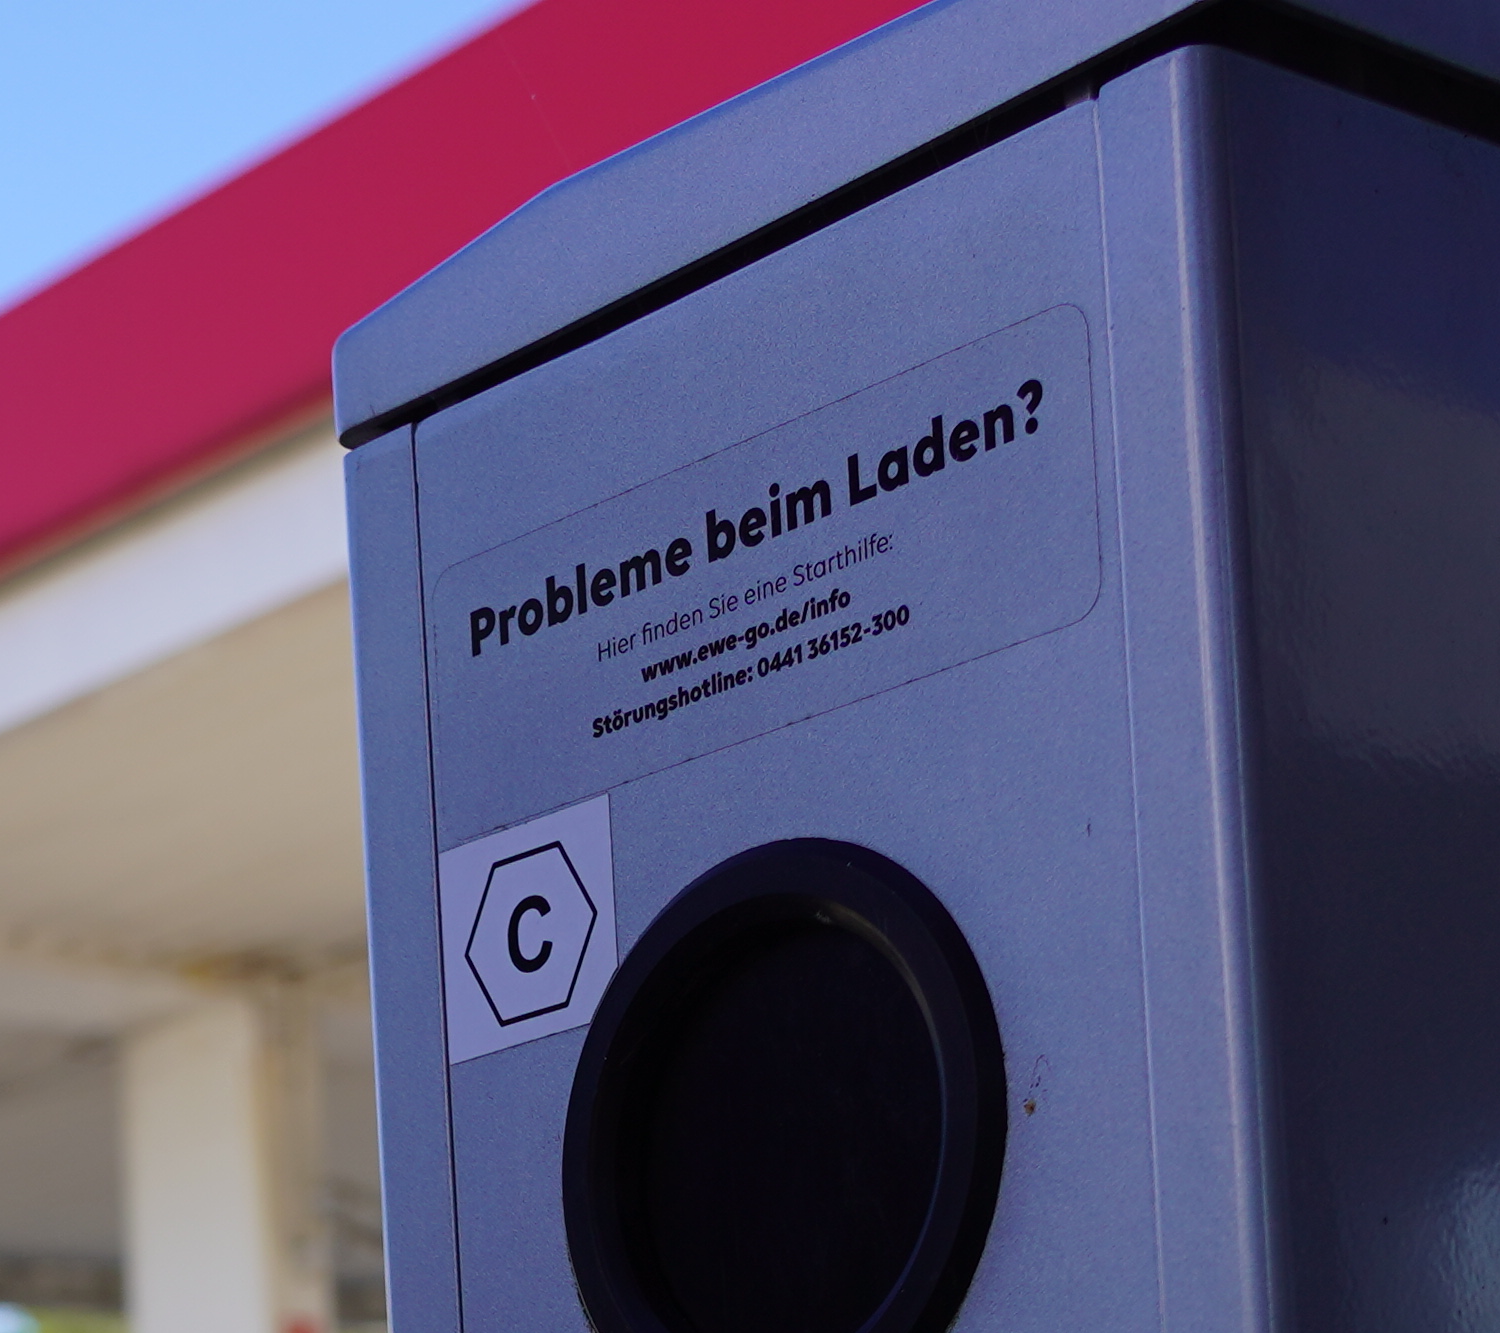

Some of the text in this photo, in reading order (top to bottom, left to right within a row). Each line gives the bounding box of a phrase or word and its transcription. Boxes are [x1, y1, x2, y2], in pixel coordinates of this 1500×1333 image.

[470, 379, 1043, 657] Probleme beim Laden?
[598, 533, 892, 662] Hier finden Sie eine Starthilfe:
[641, 588, 850, 682] www.ewe-go.de/info
[593, 605, 909, 738] Störungshotline: 0441 36152-300
[507, 894, 553, 974] C
